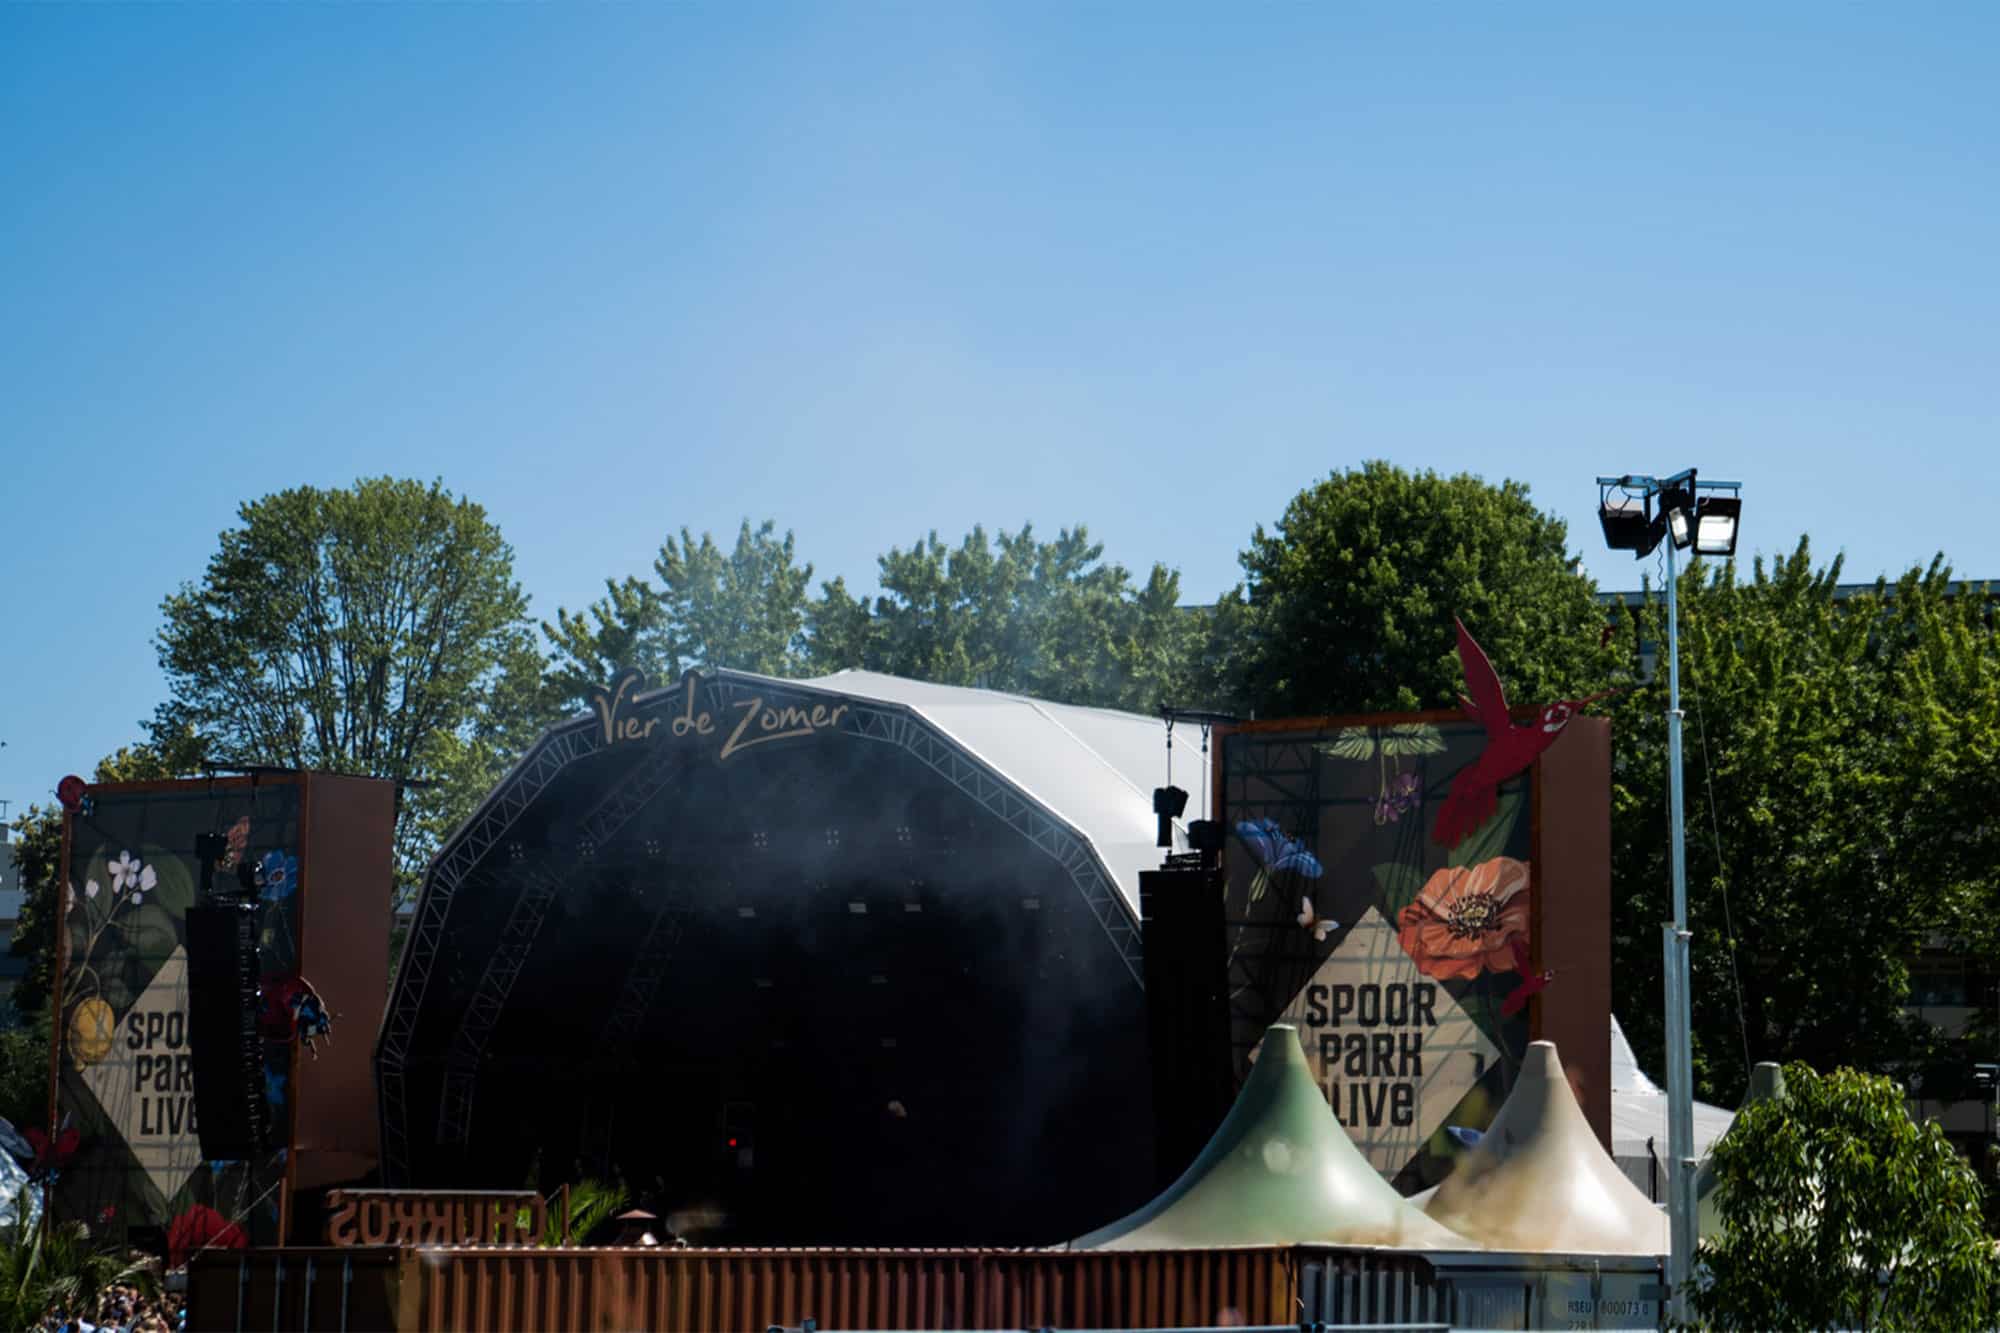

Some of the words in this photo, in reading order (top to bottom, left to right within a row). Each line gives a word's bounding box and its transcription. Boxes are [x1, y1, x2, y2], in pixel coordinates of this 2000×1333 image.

[594, 672, 661, 745] Vier
[672, 675, 715, 737] de
[719, 697, 849, 760] Zomer
[1306, 983, 1438, 1028] SPOOR
[127, 1010, 192, 1050] SPO
